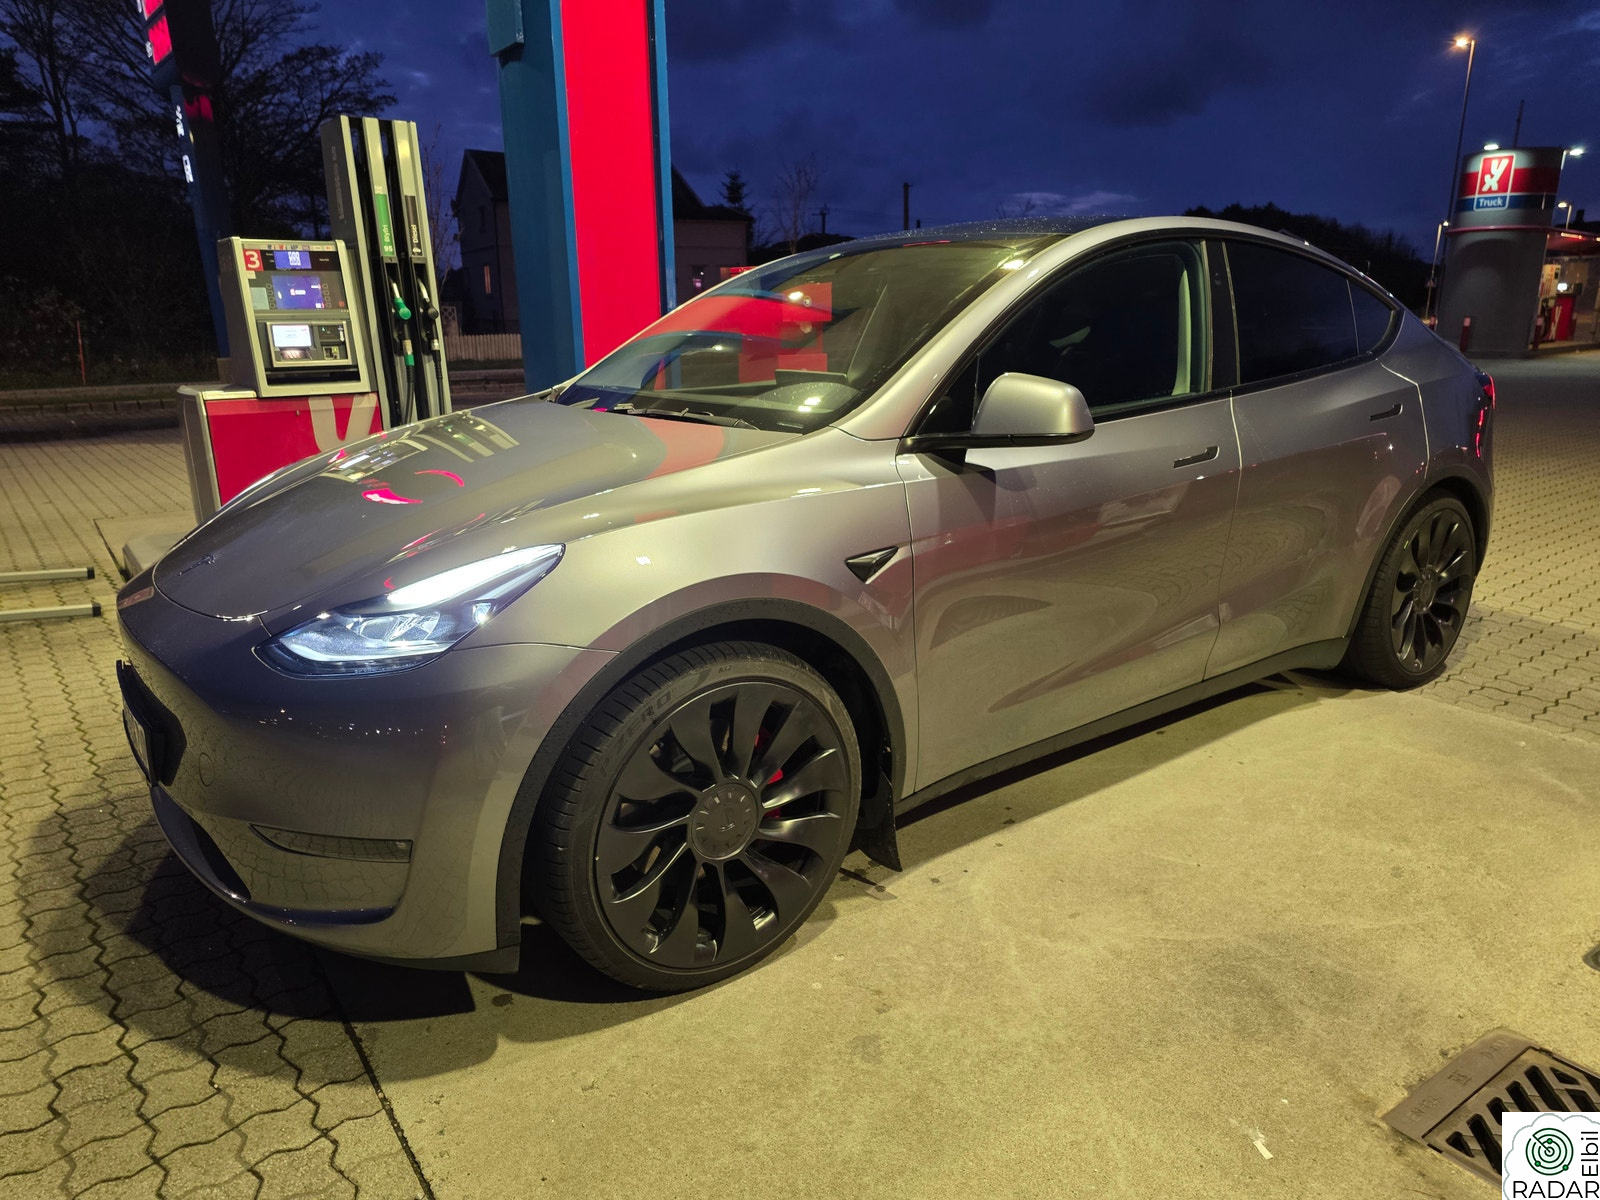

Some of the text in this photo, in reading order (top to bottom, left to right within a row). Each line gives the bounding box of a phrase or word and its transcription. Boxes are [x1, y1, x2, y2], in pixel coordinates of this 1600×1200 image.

[1479, 196, 1503, 207] Truck
[381, 224, 391, 243] Blyfri
[410, 224, 419, 243] Diesel
[245, 250, 260, 269] 3
